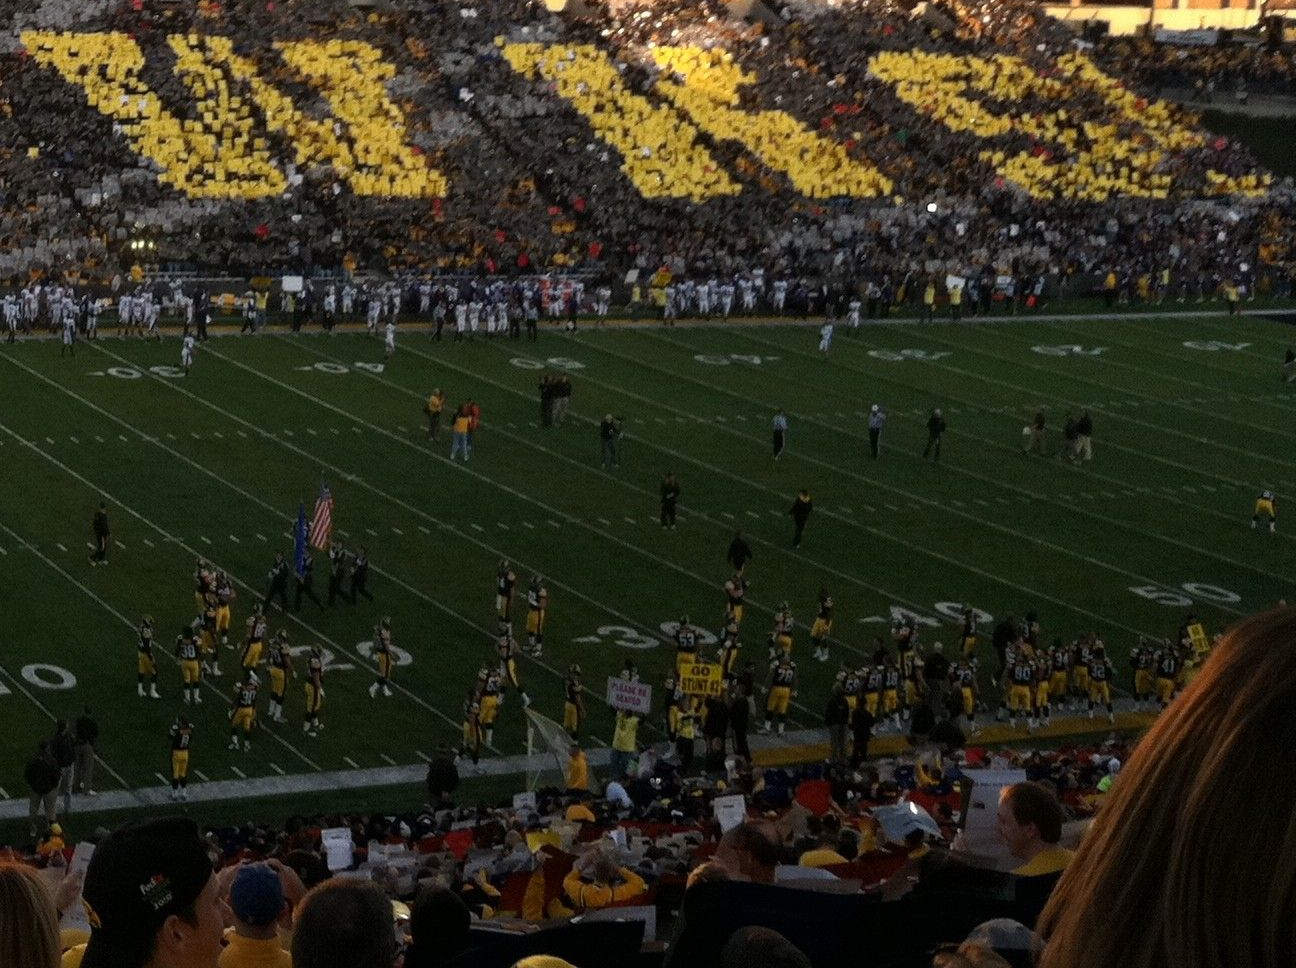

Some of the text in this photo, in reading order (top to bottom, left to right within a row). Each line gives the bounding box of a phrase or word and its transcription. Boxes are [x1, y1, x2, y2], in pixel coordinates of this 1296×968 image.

[1127, 582, 1242, 607] 50
[691, 665, 711, 677] GO
[681, 677, 707, 692] STUNT
